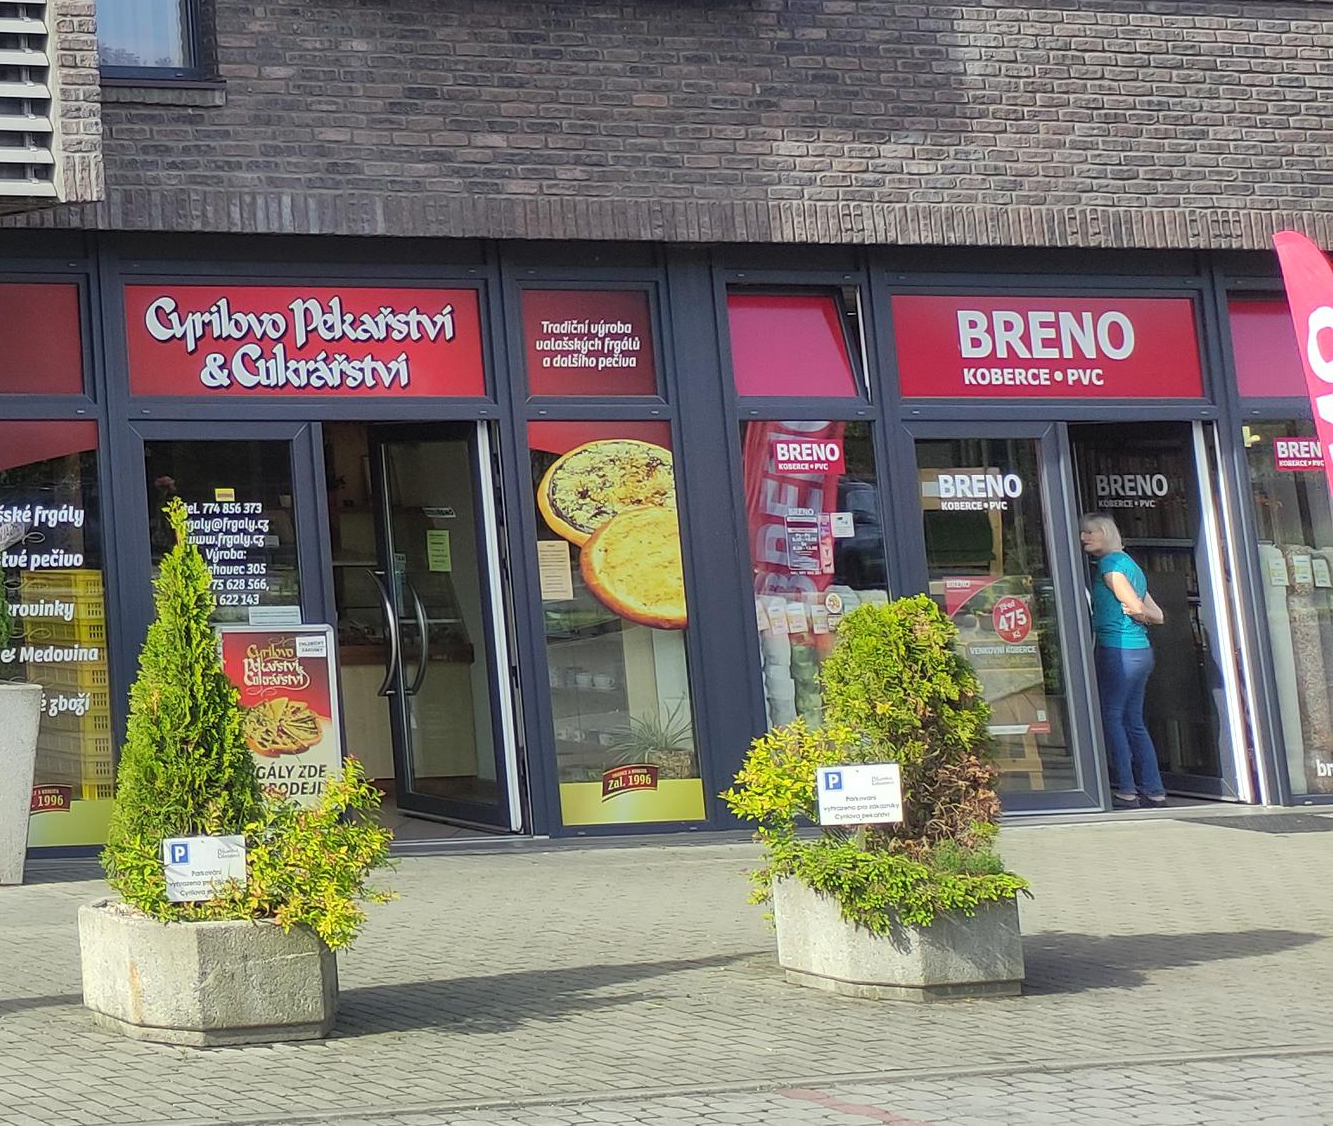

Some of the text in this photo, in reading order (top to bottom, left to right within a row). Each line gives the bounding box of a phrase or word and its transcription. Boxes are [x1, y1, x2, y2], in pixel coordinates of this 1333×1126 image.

[145, 296, 457, 353] Cyrilovo Pekařství
[541, 320, 632, 337] Tradiční výroba
[956, 310, 1136, 361] BRENO
[535, 336, 641, 354] valašských frgálů
[200, 343, 410, 389] & Cukrářství
[543, 353, 637, 370] a dalšího pečiva
[963, 368, 1104, 385] KOBERCE PVC
[777, 443, 840, 461] BRENO
[1277, 441, 1323, 458] BREN
[938, 474, 1022, 498] BRENO
[1096, 474, 1168, 496] BRENO
[202, 503, 220, 514] 774
[222, 503, 241, 514] 856
[243, 502, 263, 514] 373
[941, 501, 1007, 510] KOBERCE PVC
[1098, 500, 1155, 508] KOBERCE PVC
[34, 505, 85, 528] frgály
[187, 517, 270, 534] galy@frgaly.cz
[30, 548, 84, 571] pečivo
[205, 548, 247, 563] Výroba:
[246, 563, 266, 575] 305
[212, 579, 270, 591] 75 628 566,
[219, 594, 239, 605] 622
[241, 594, 259, 605] 143
[998, 609, 1027, 631] 475
[20, 645, 99, 663] Medovina
[1006, 645, 1037, 654] KOBERCE
[48, 693, 90, 717] zboží
[255, 761, 327, 779] GÁLY ZDE
[628, 774, 651, 786] 1996
[38, 795, 64, 807] 1996
